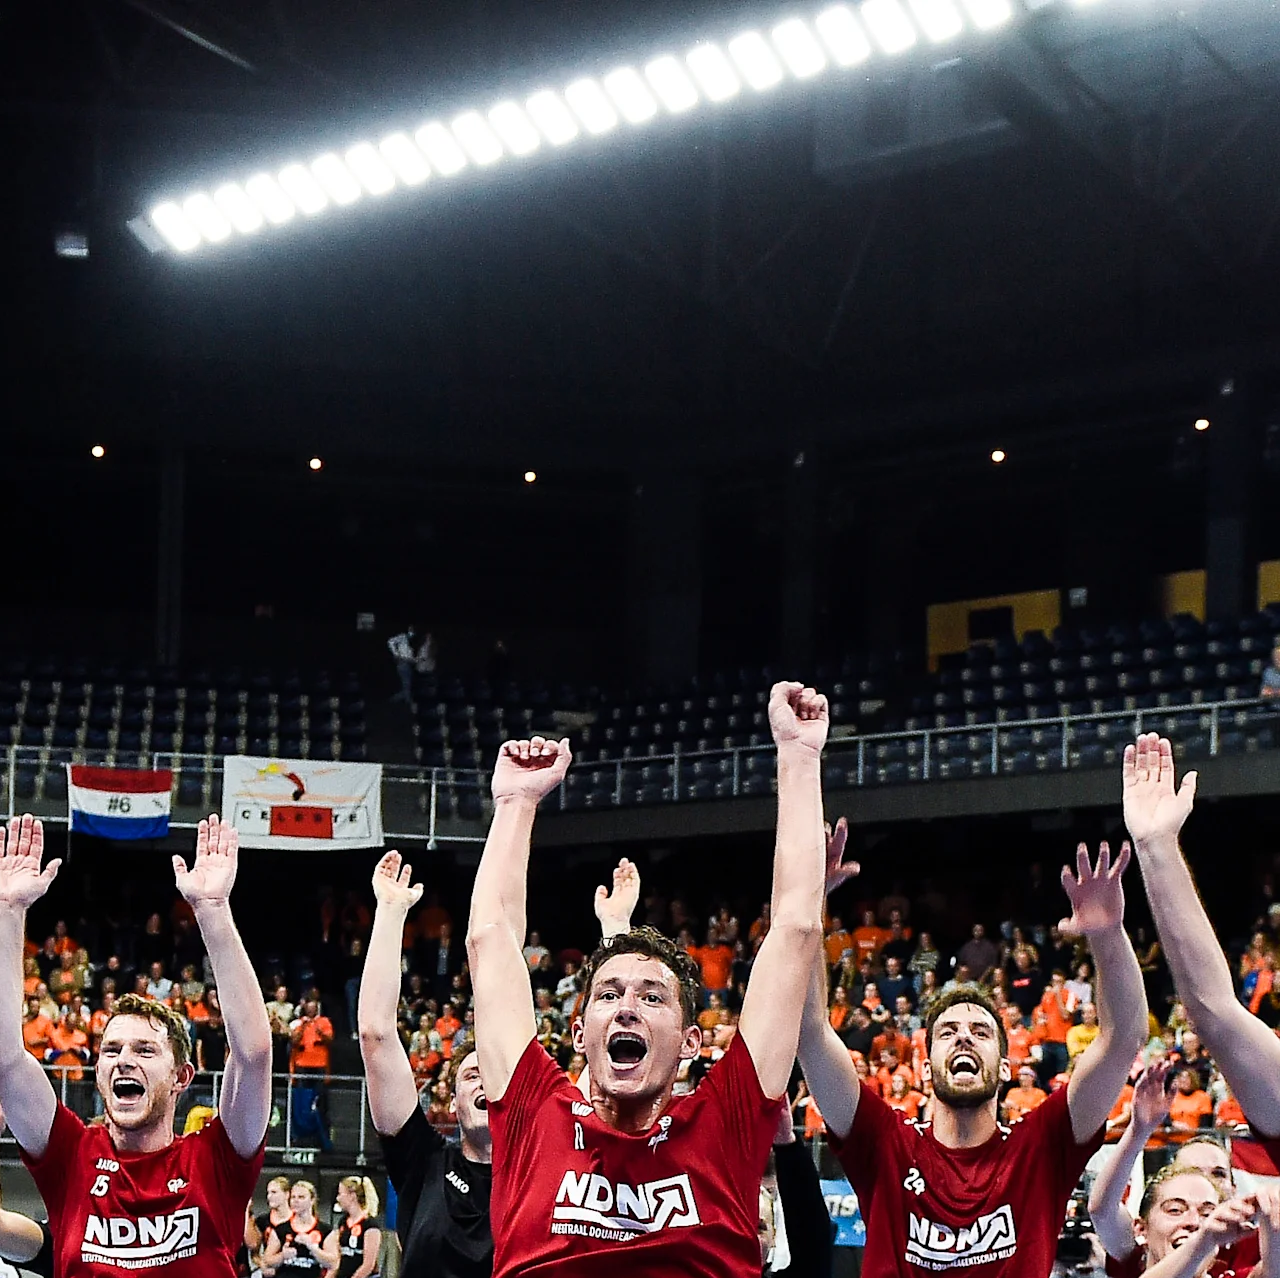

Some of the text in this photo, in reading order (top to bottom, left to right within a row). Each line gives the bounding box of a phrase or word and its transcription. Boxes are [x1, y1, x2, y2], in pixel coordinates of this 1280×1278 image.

[108, 796, 131, 813] #6
[90, 1174, 111, 1197] 15
[445, 1170, 470, 1193] JAKO
[555, 1171, 650, 1219] NDN
[903, 1167, 925, 1195] 24
[84, 1214, 165, 1246] NDN
[910, 1211, 979, 1251] NDN
